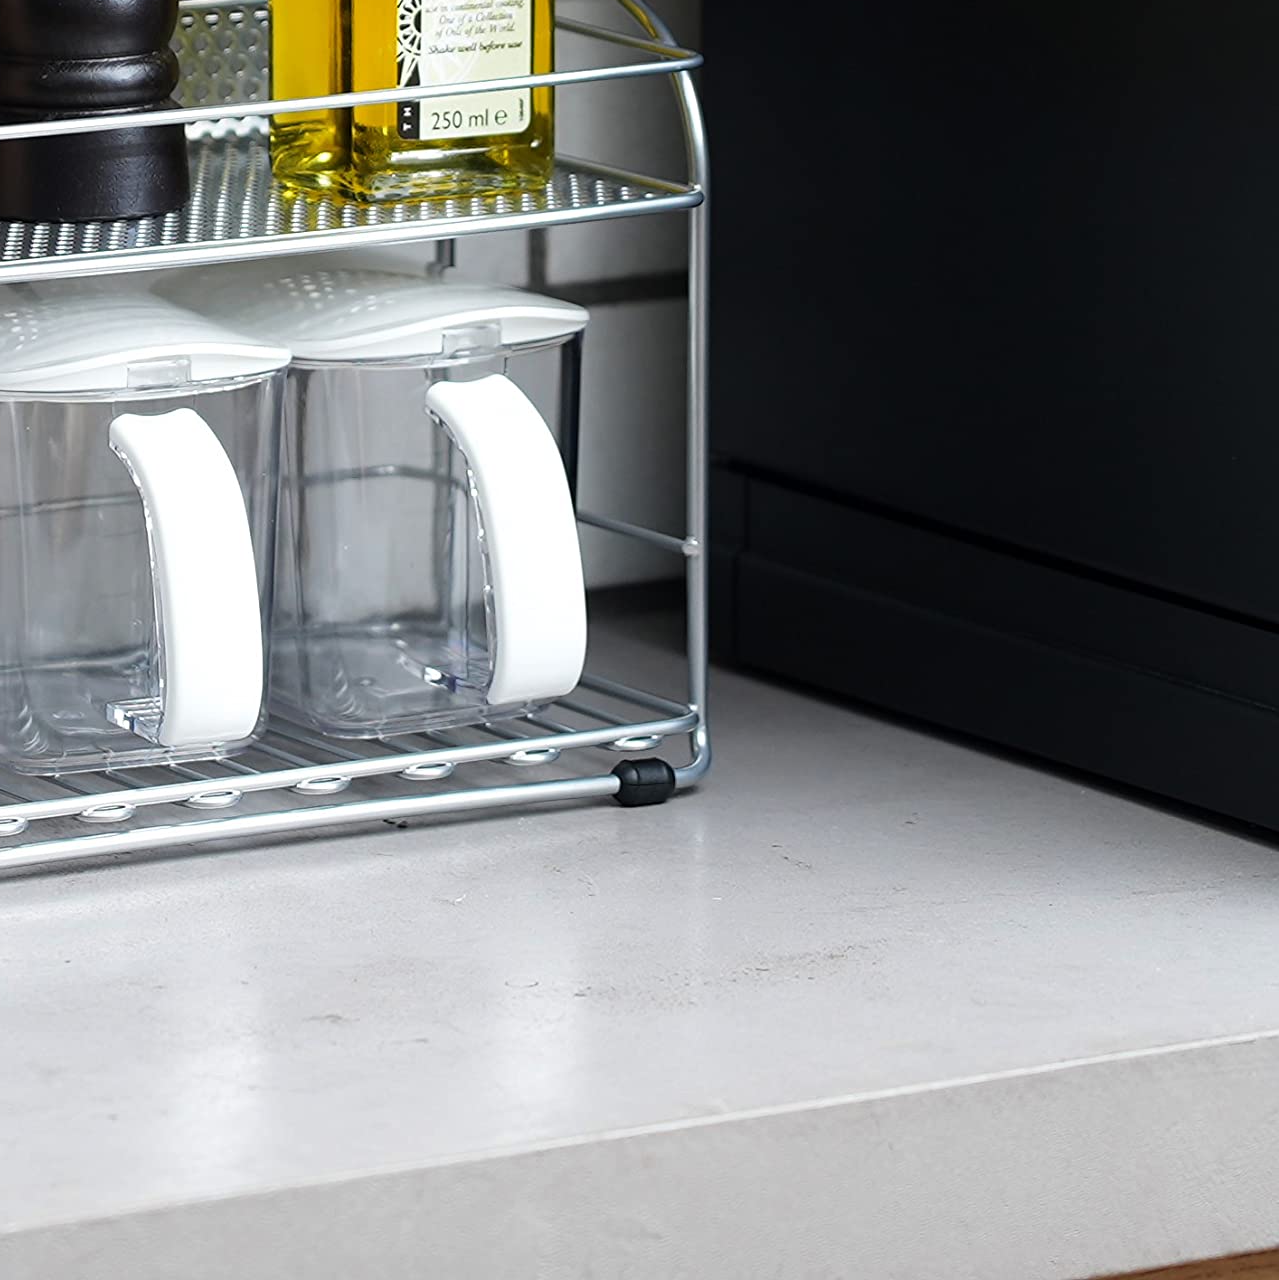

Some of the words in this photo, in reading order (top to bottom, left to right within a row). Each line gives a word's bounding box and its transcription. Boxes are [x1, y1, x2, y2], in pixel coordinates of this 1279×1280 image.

[457, 42, 477, 52] well
[479, 40, 506, 53] before
[431, 110, 463, 130] 250
[468, 108, 489, 127] ml
